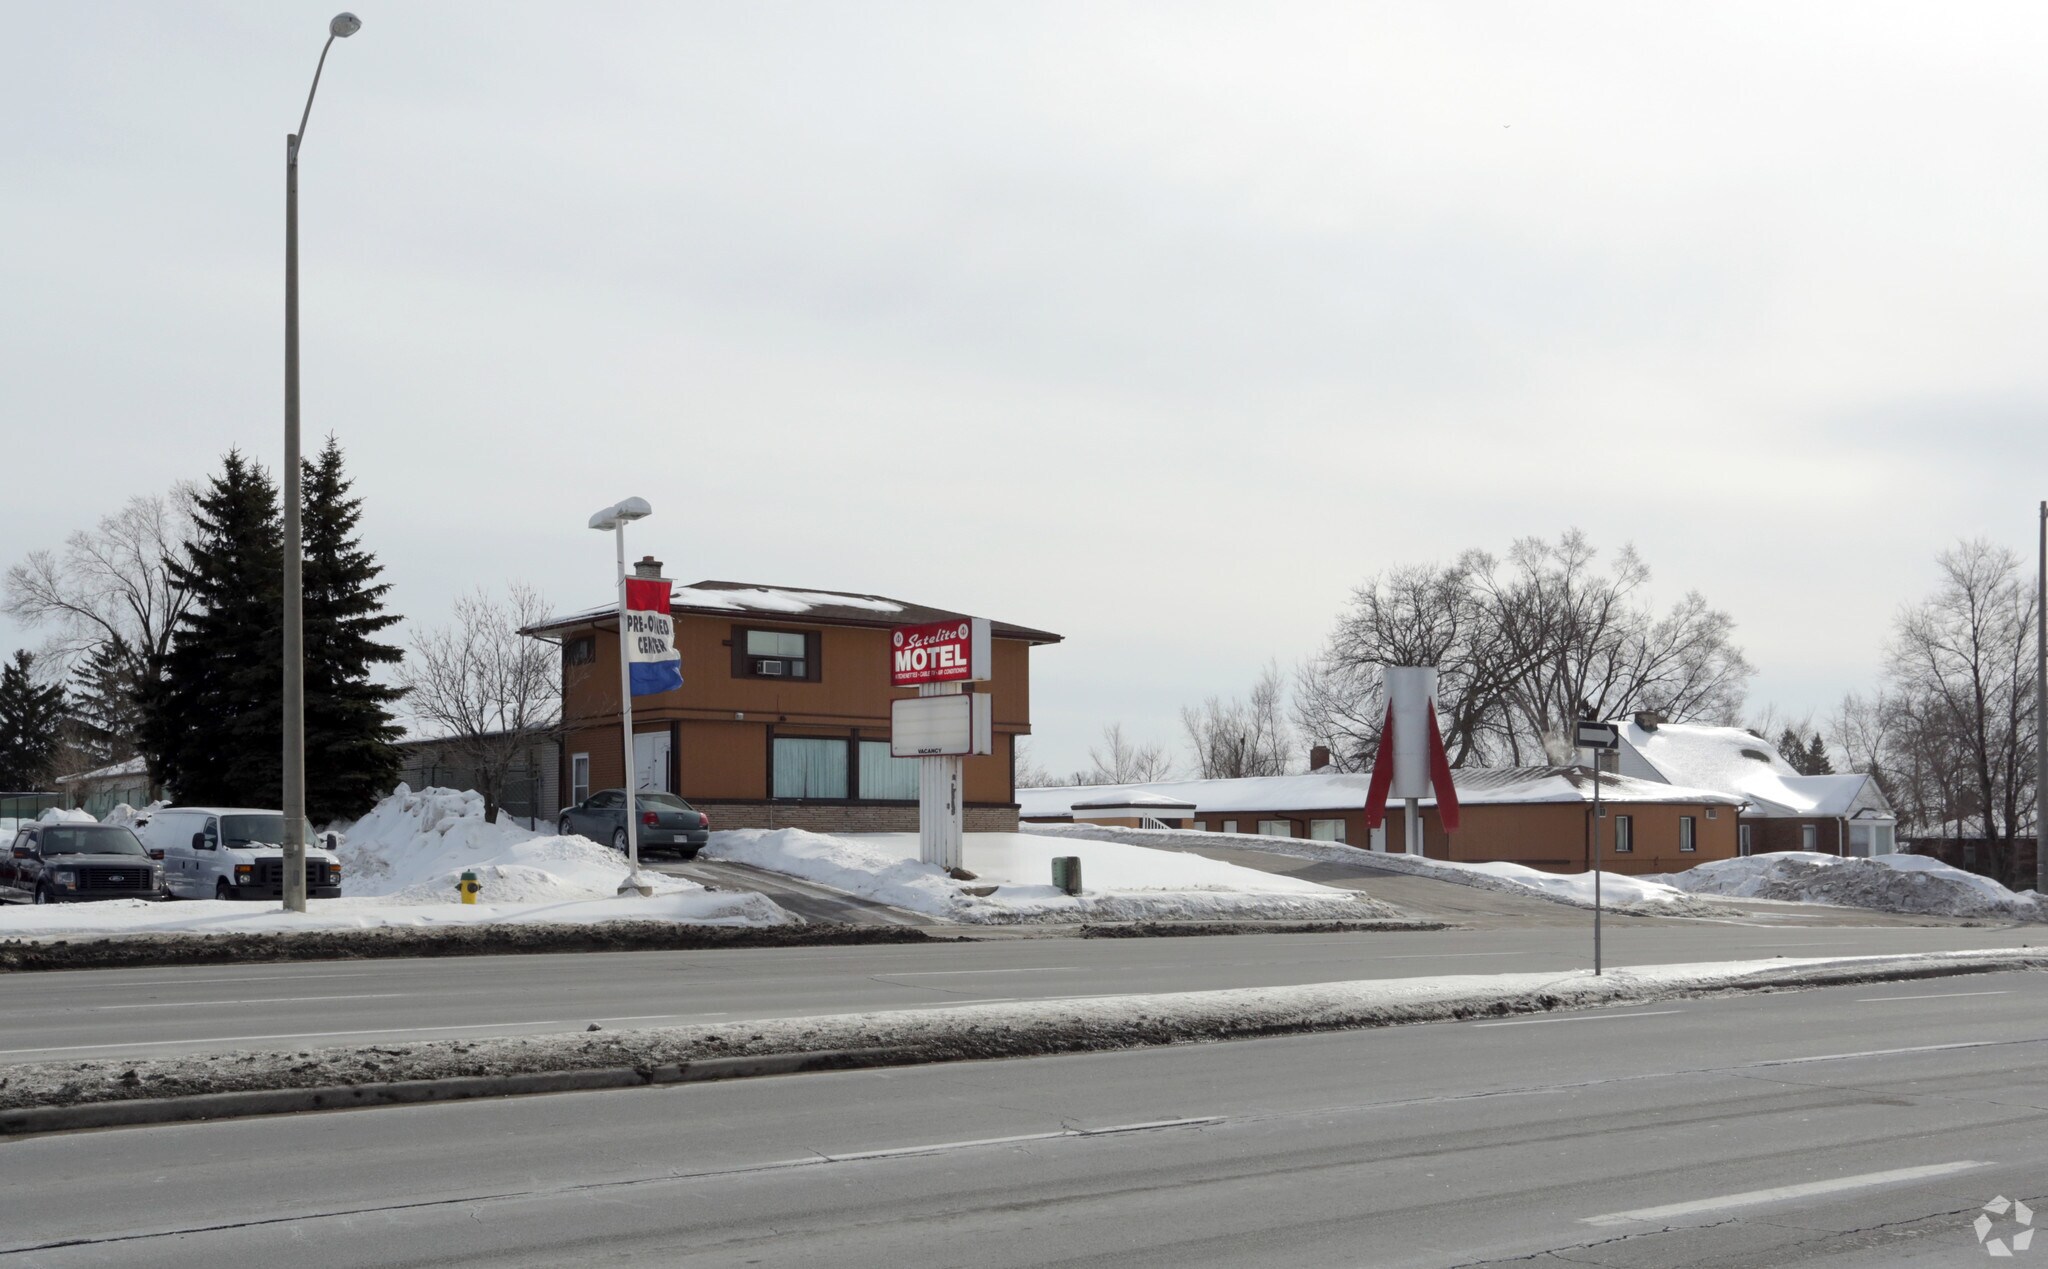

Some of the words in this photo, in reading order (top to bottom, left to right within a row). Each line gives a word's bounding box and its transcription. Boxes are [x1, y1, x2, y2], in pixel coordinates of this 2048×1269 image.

[904, 629, 957, 649] Satelite
[895, 644, 967, 672] MOTEL
[944, 667, 967, 675] CONDITIONING
